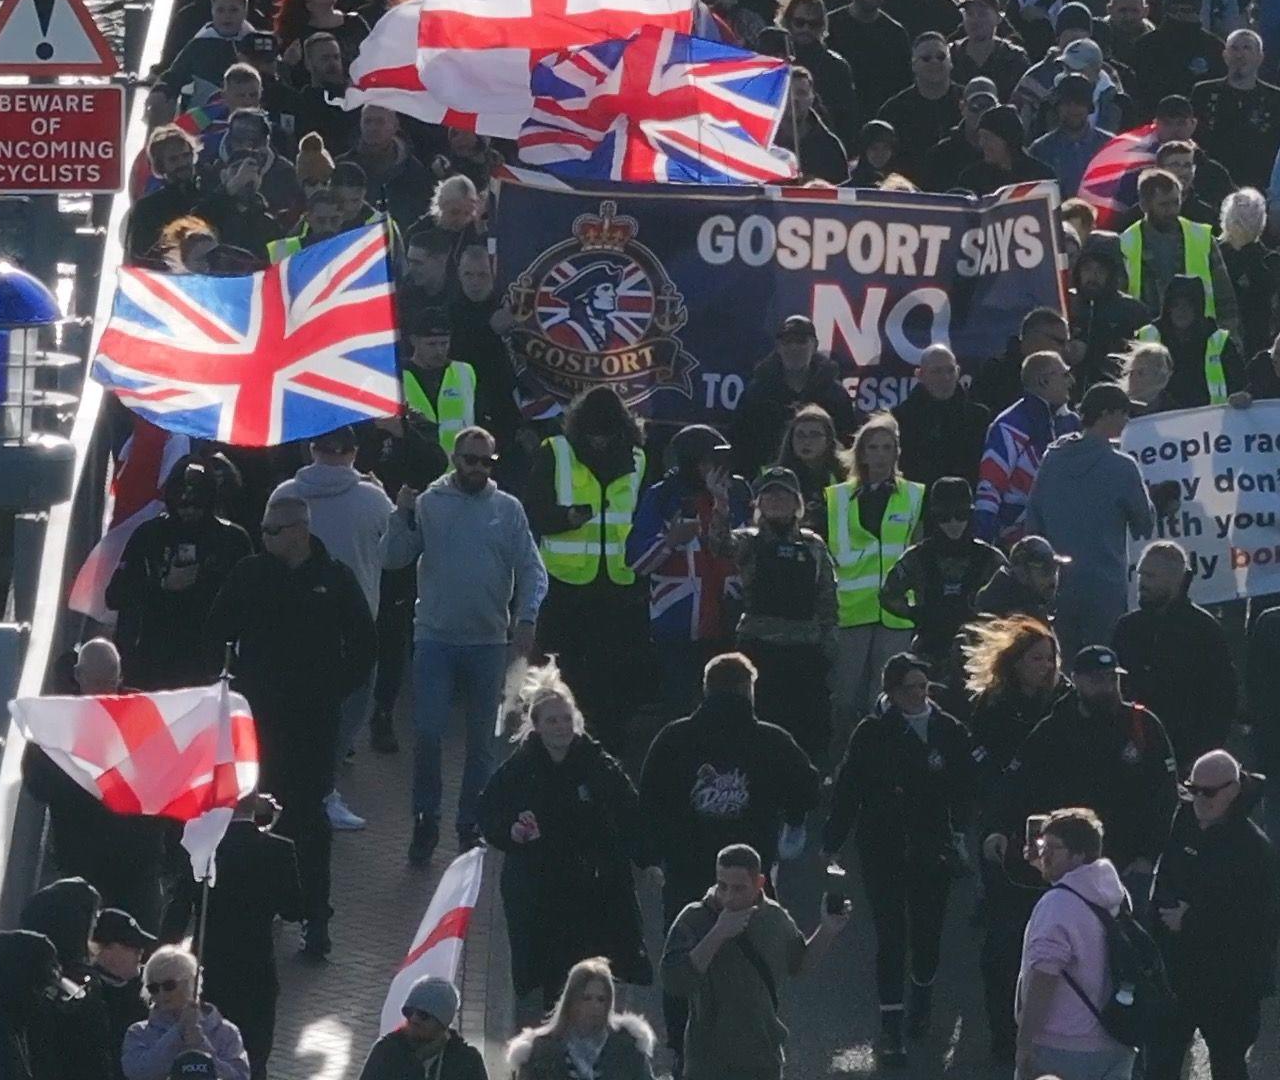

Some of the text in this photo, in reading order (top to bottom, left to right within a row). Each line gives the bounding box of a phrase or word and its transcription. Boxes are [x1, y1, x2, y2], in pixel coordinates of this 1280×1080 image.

[30, 117, 61, 136] OF
[697, 214, 1045, 277] GOSPORT SAYS
[813, 284, 951, 367] NO
[524, 338, 656, 376] GOSPORT
[701, 372, 745, 411] TO
[1214, 509, 1277, 539] you
